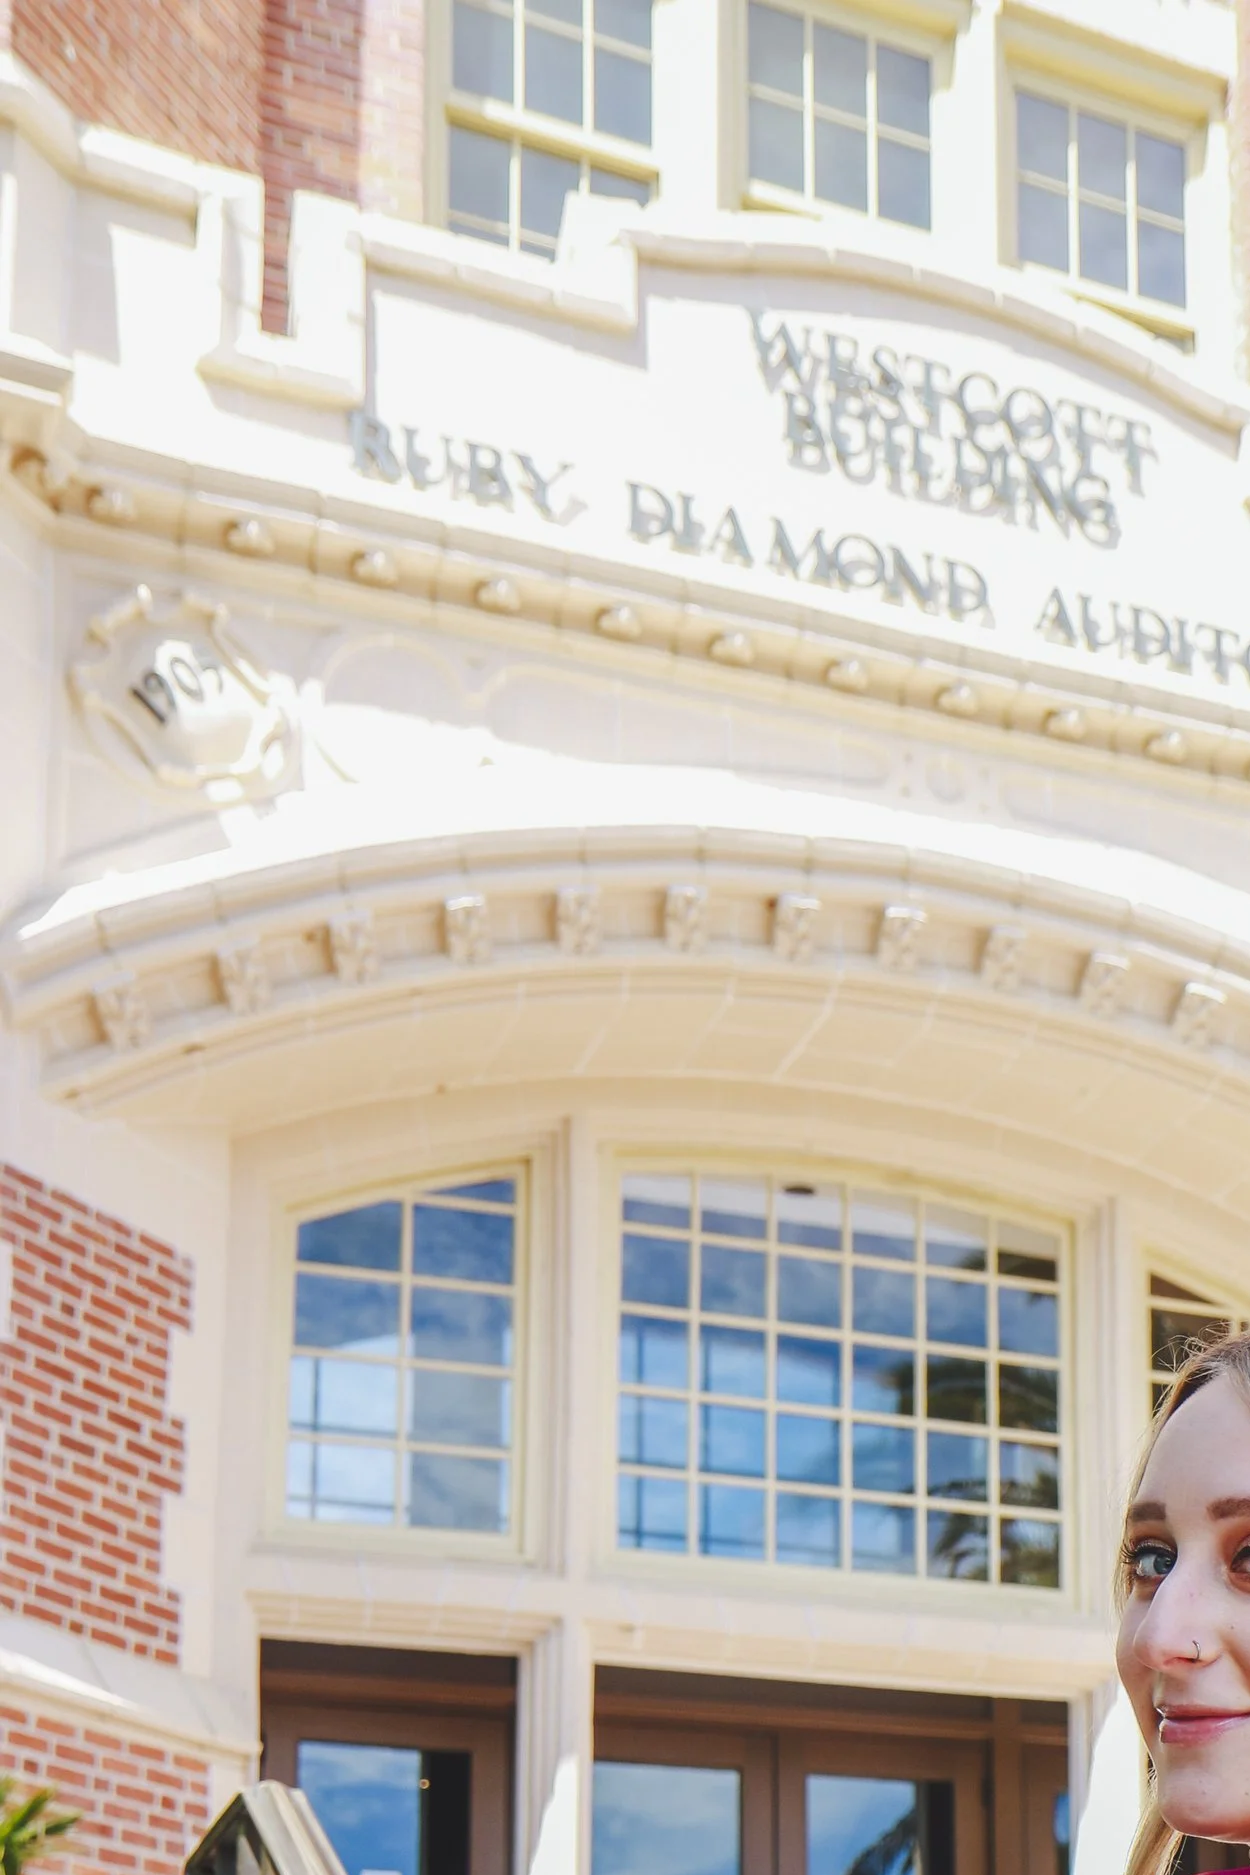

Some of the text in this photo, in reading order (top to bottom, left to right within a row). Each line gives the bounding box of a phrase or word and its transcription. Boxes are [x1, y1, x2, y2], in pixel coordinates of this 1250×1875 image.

[743, 306, 1154, 482] WESTCOTT
[782, 391, 1117, 542] BUILDING
[348, 408, 574, 522] RUBY
[625, 480, 991, 621] DIAMOND
